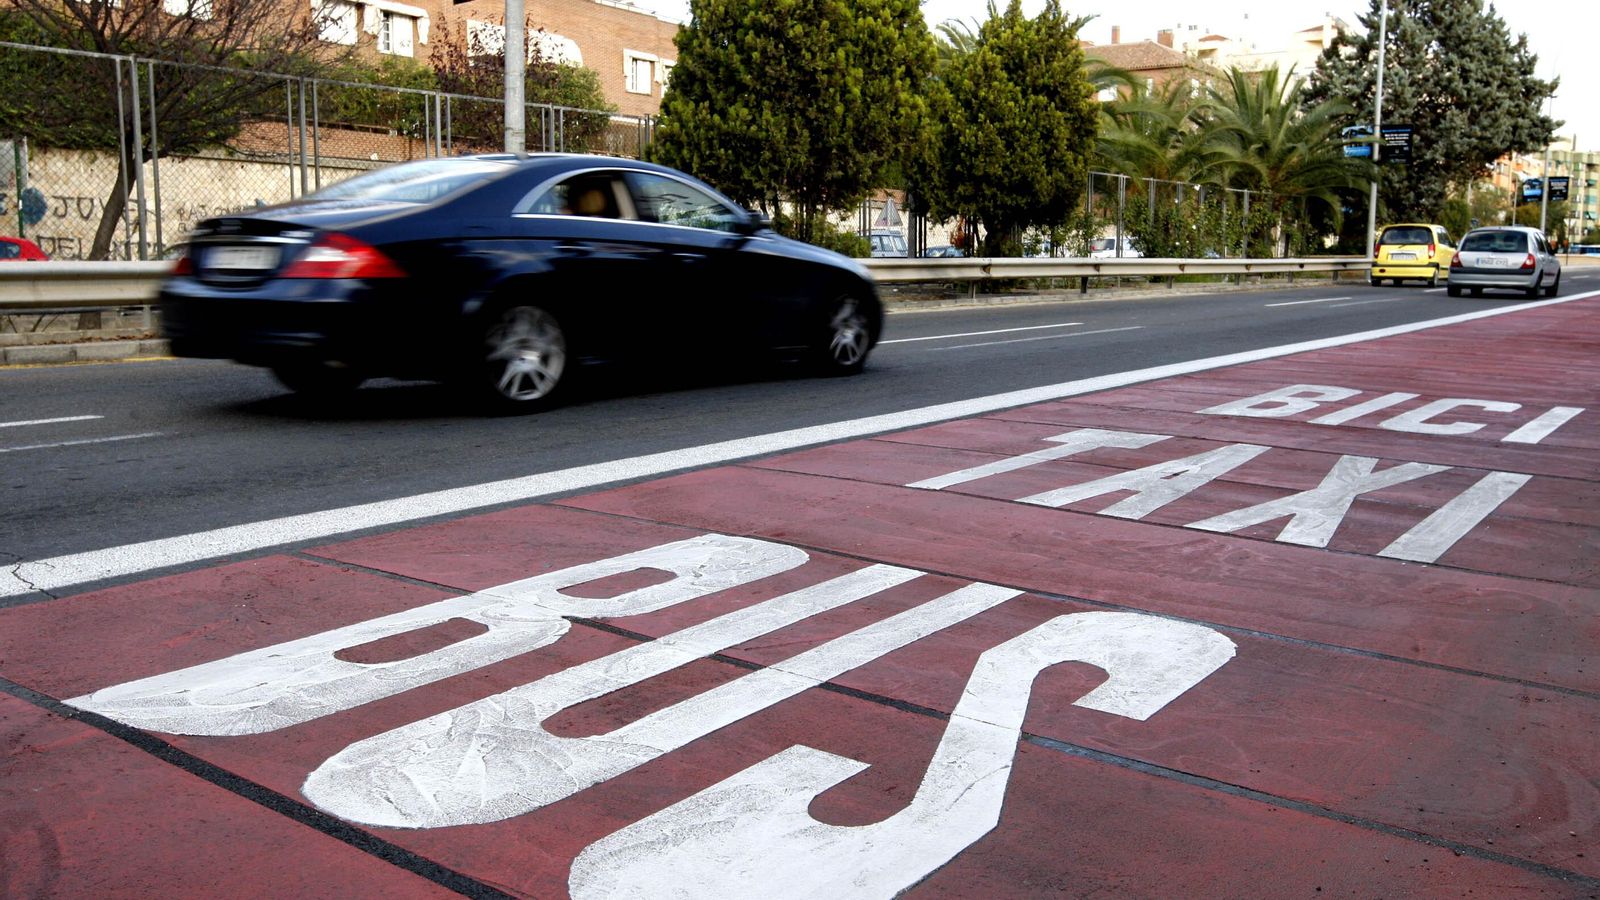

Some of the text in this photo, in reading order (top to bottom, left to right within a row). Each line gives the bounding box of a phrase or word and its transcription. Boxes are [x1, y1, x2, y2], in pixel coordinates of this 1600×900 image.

[1196, 384, 1585, 444] BICI
[905, 428, 1533, 564] TAXI
[62, 533, 1238, 900] BUS
